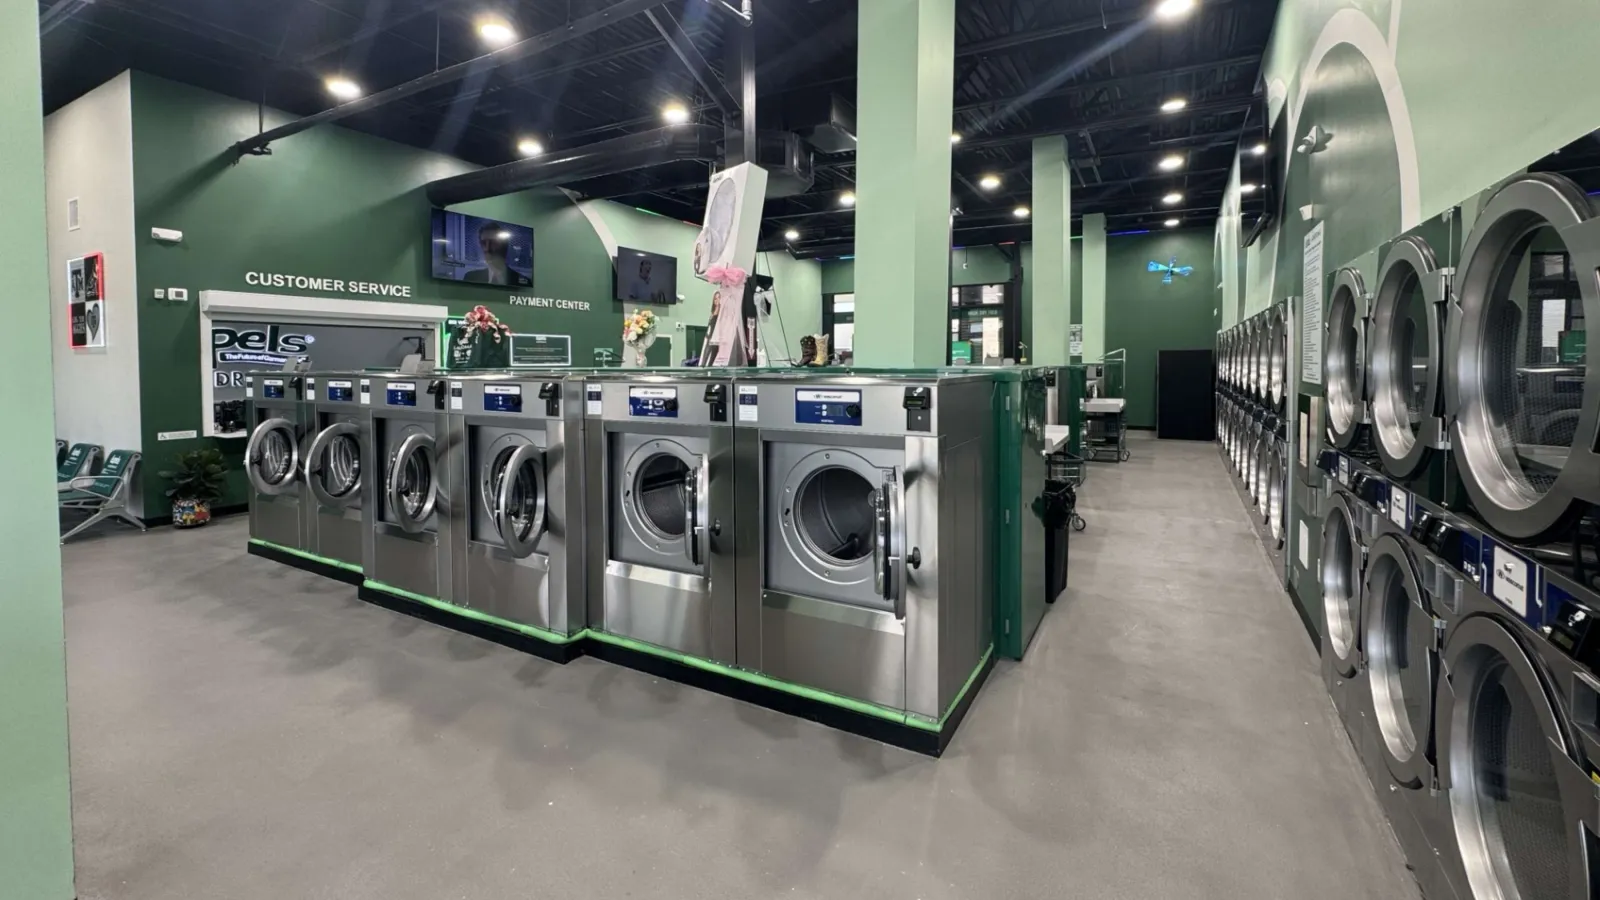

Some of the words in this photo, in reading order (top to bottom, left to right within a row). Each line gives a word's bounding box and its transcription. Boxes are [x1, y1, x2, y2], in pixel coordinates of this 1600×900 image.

[245, 271, 345, 292] CUSTOMER
[348, 281, 412, 298] SERVICE
[509, 295, 555, 308] PAYMENT
[555, 299, 591, 311] CENTER
